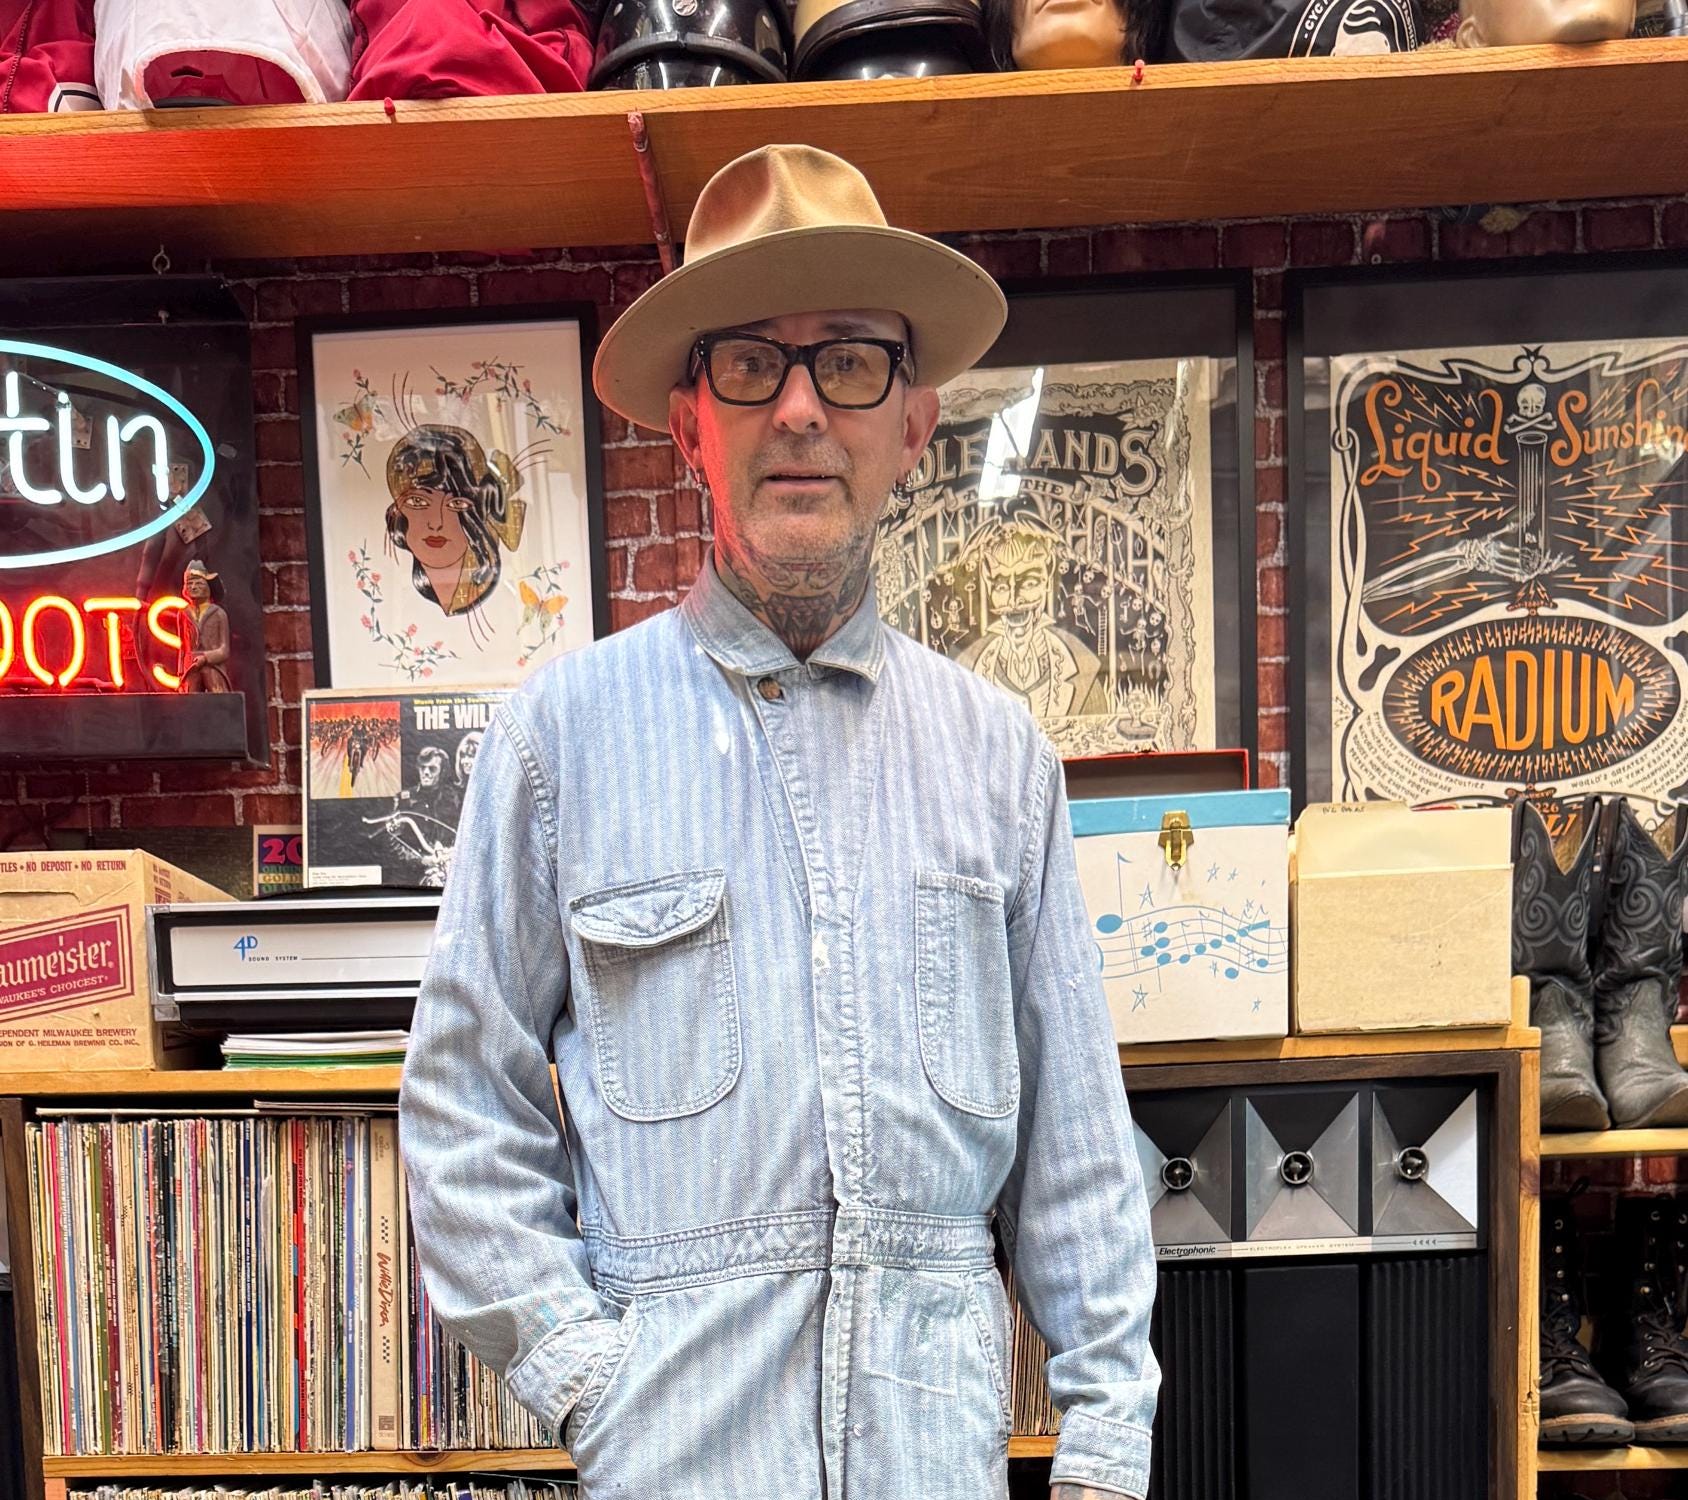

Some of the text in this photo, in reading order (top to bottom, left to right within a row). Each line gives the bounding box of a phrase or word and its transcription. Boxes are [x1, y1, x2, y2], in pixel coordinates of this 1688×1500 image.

[1360, 379, 1510, 493] Liquid
[910, 428, 1159, 496] DLE ANDS
[1021, 481, 1065, 496] THE
[0, 595, 190, 689] OTS
[1430, 648, 1635, 751] RADIUM
[413, 705, 450, 730] THE
[26, 861, 37, 872] NO
[40, 860, 73, 872] DEPOSIT
[81, 860, 92, 871] NO
[96, 860, 127, 871] RETURN
[16, 1039, 25, 1047] OF
[73, 1039, 106, 1047] BREWING
[43, 1028, 94, 1037] MILWAUKEE
[96, 1028, 138, 1037] BREWERY
[1159, 1246, 1217, 1258] Electrophonic
[376, 1252, 393, 1289] Willie
